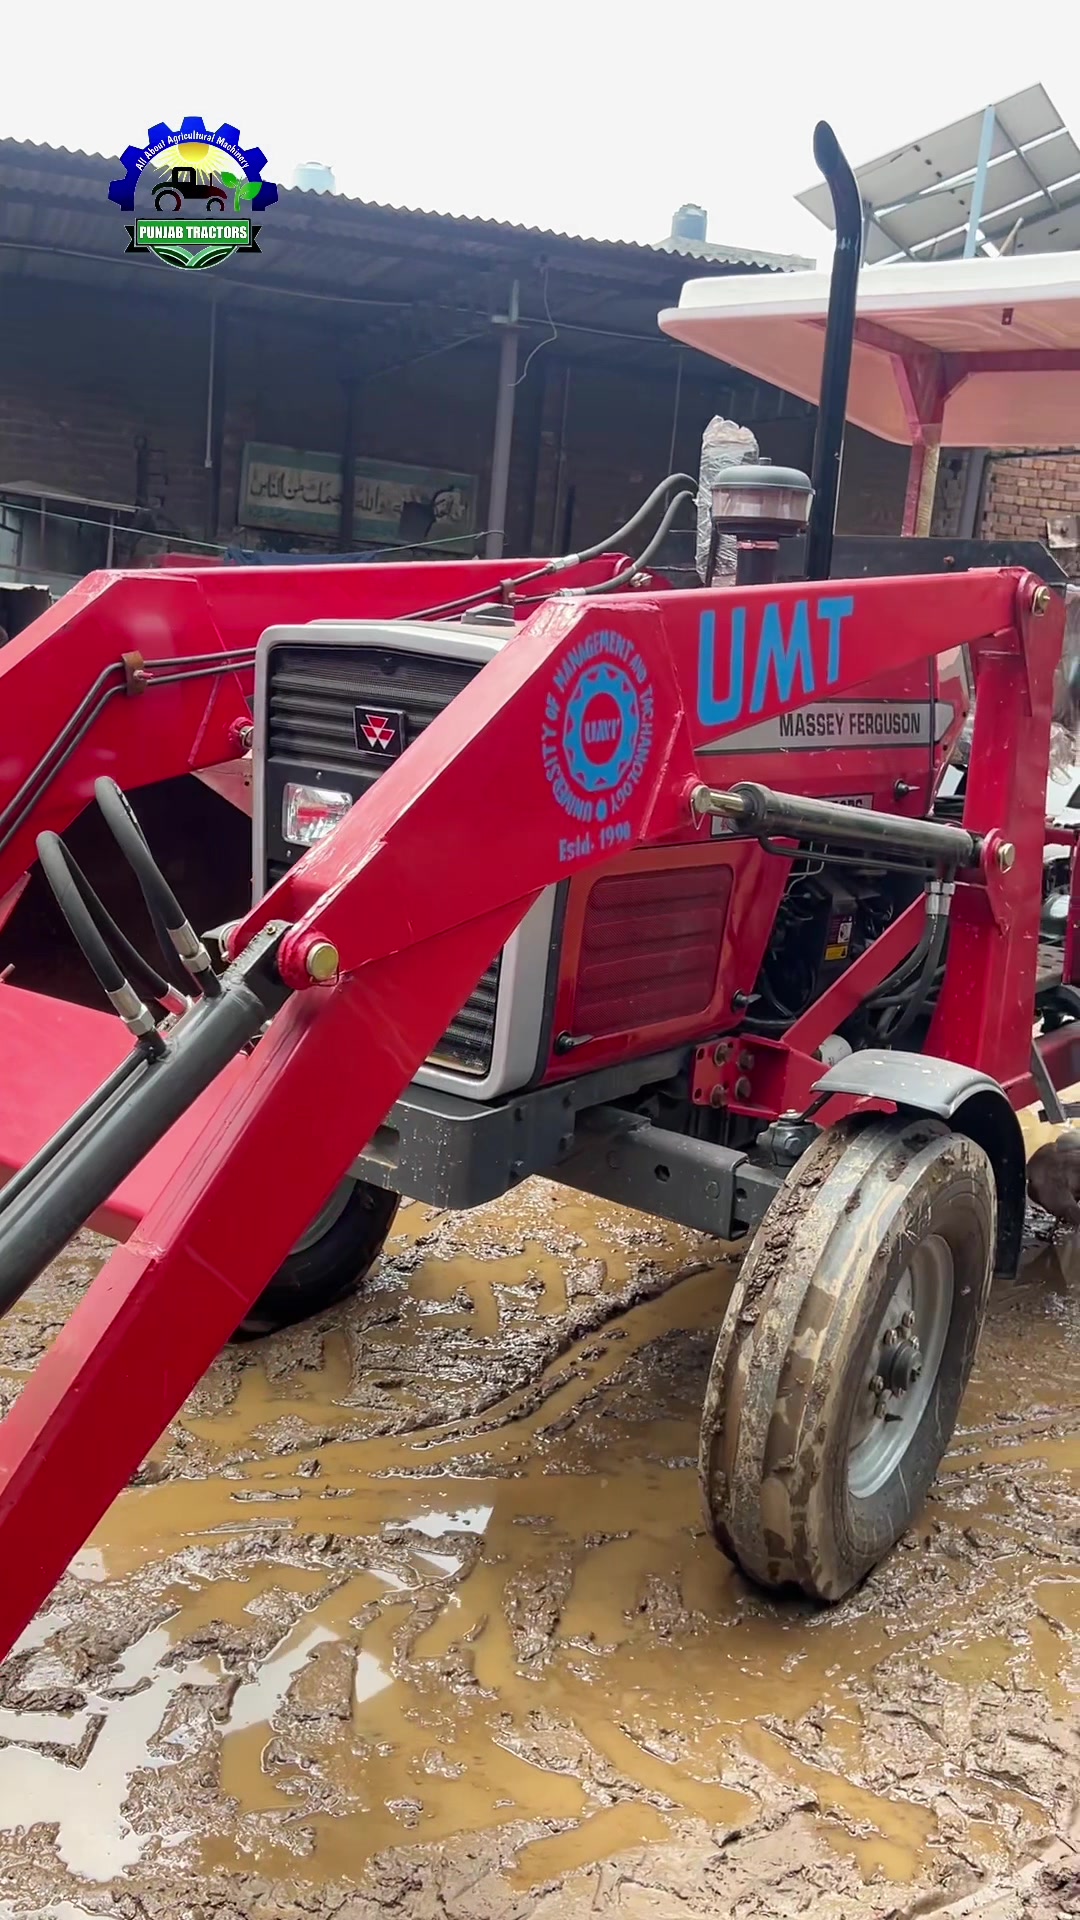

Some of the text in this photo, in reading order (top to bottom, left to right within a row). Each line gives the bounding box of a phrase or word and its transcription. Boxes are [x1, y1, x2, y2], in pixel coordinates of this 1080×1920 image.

[552, 629, 636, 693] MANAGEMENT
[696, 595, 854, 727] UMT
[544, 691, 561, 722] OF
[779, 712, 921, 737] MASSEY FERGUSON
